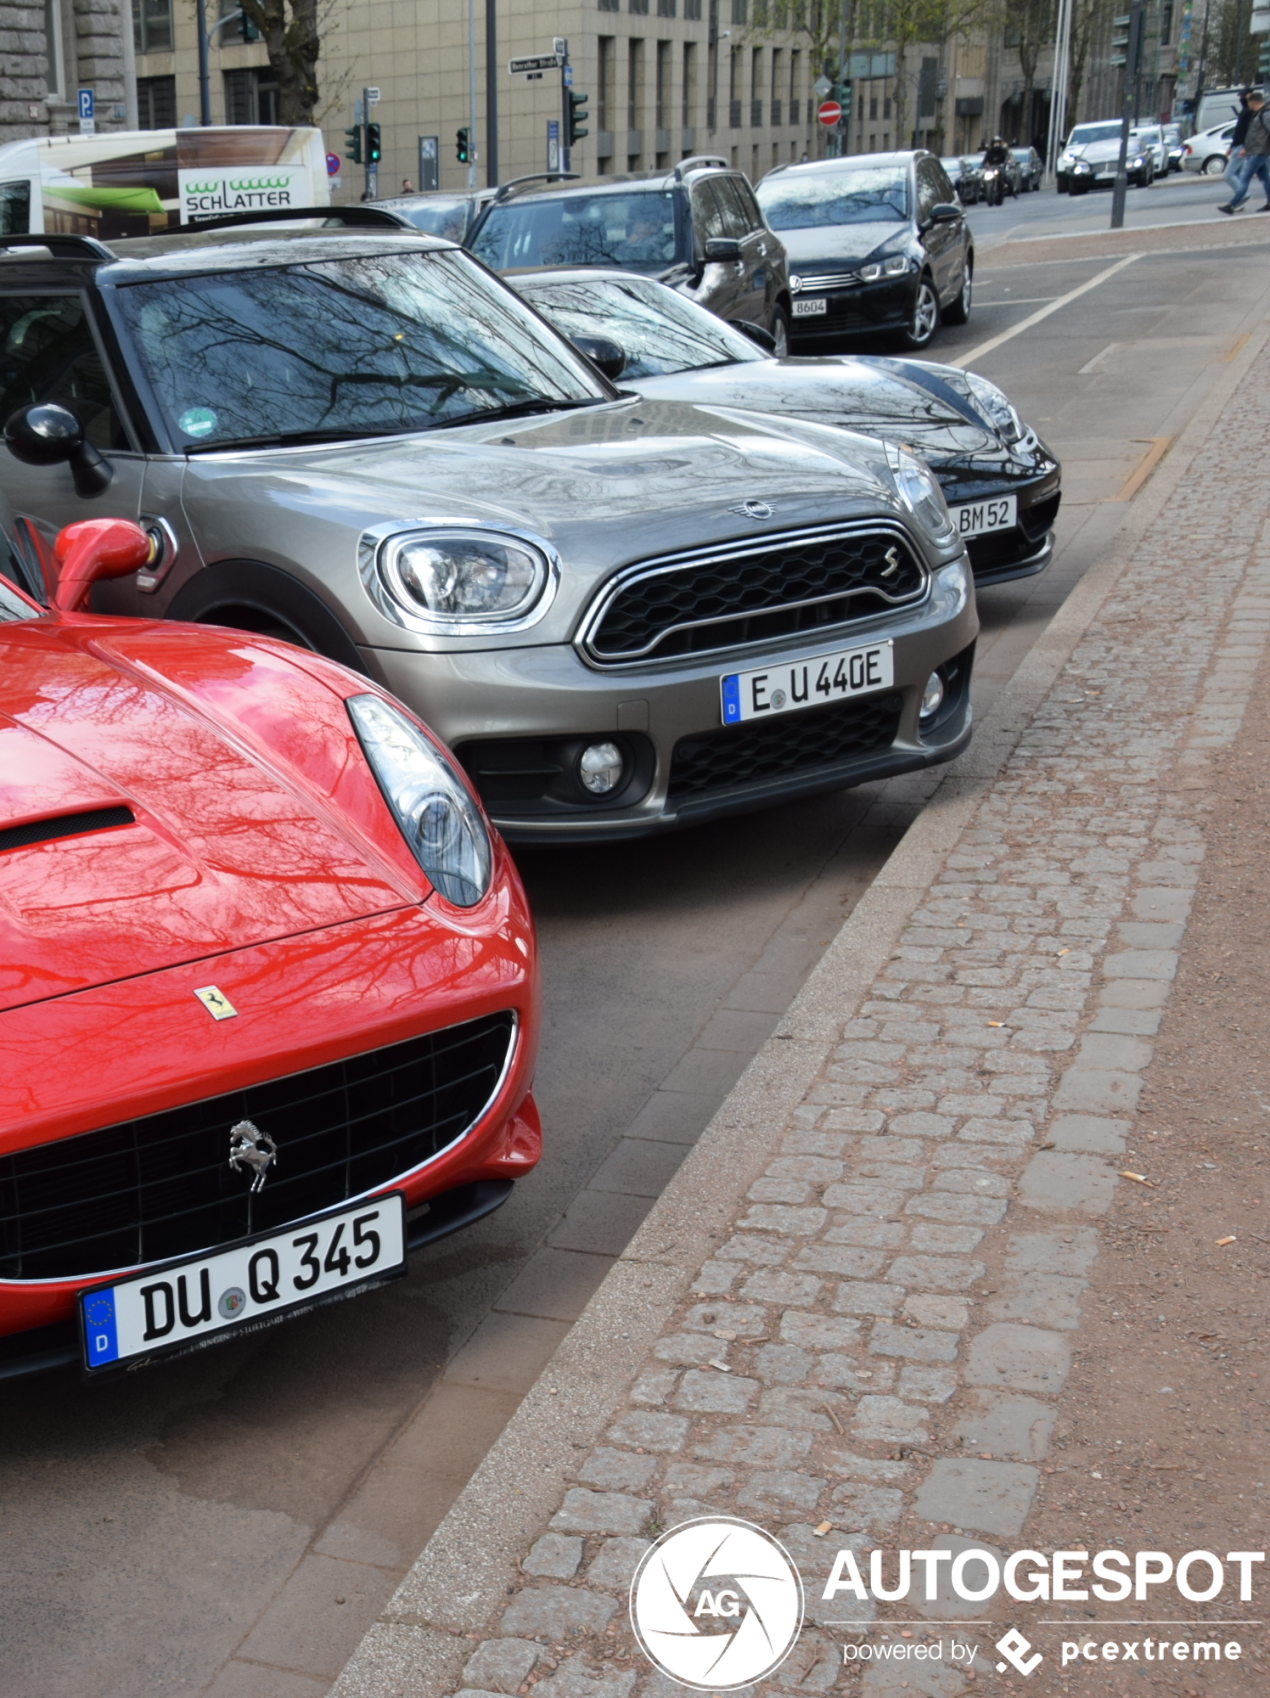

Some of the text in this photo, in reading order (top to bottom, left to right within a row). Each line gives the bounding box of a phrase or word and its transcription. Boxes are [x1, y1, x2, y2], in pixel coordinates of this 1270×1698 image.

[81, 93, 91, 117] P
[186, 180, 291, 211] SCHLATTER
[796, 301, 824, 314] 8604
[959, 501, 1009, 533] BM 52
[728, 650, 882, 715] D E U 440E
[95, 1334, 108, 1353] D
[139, 1267, 212, 1343] DU
[248, 1247, 281, 1305] Q
[292, 1210, 381, 1292] 345
